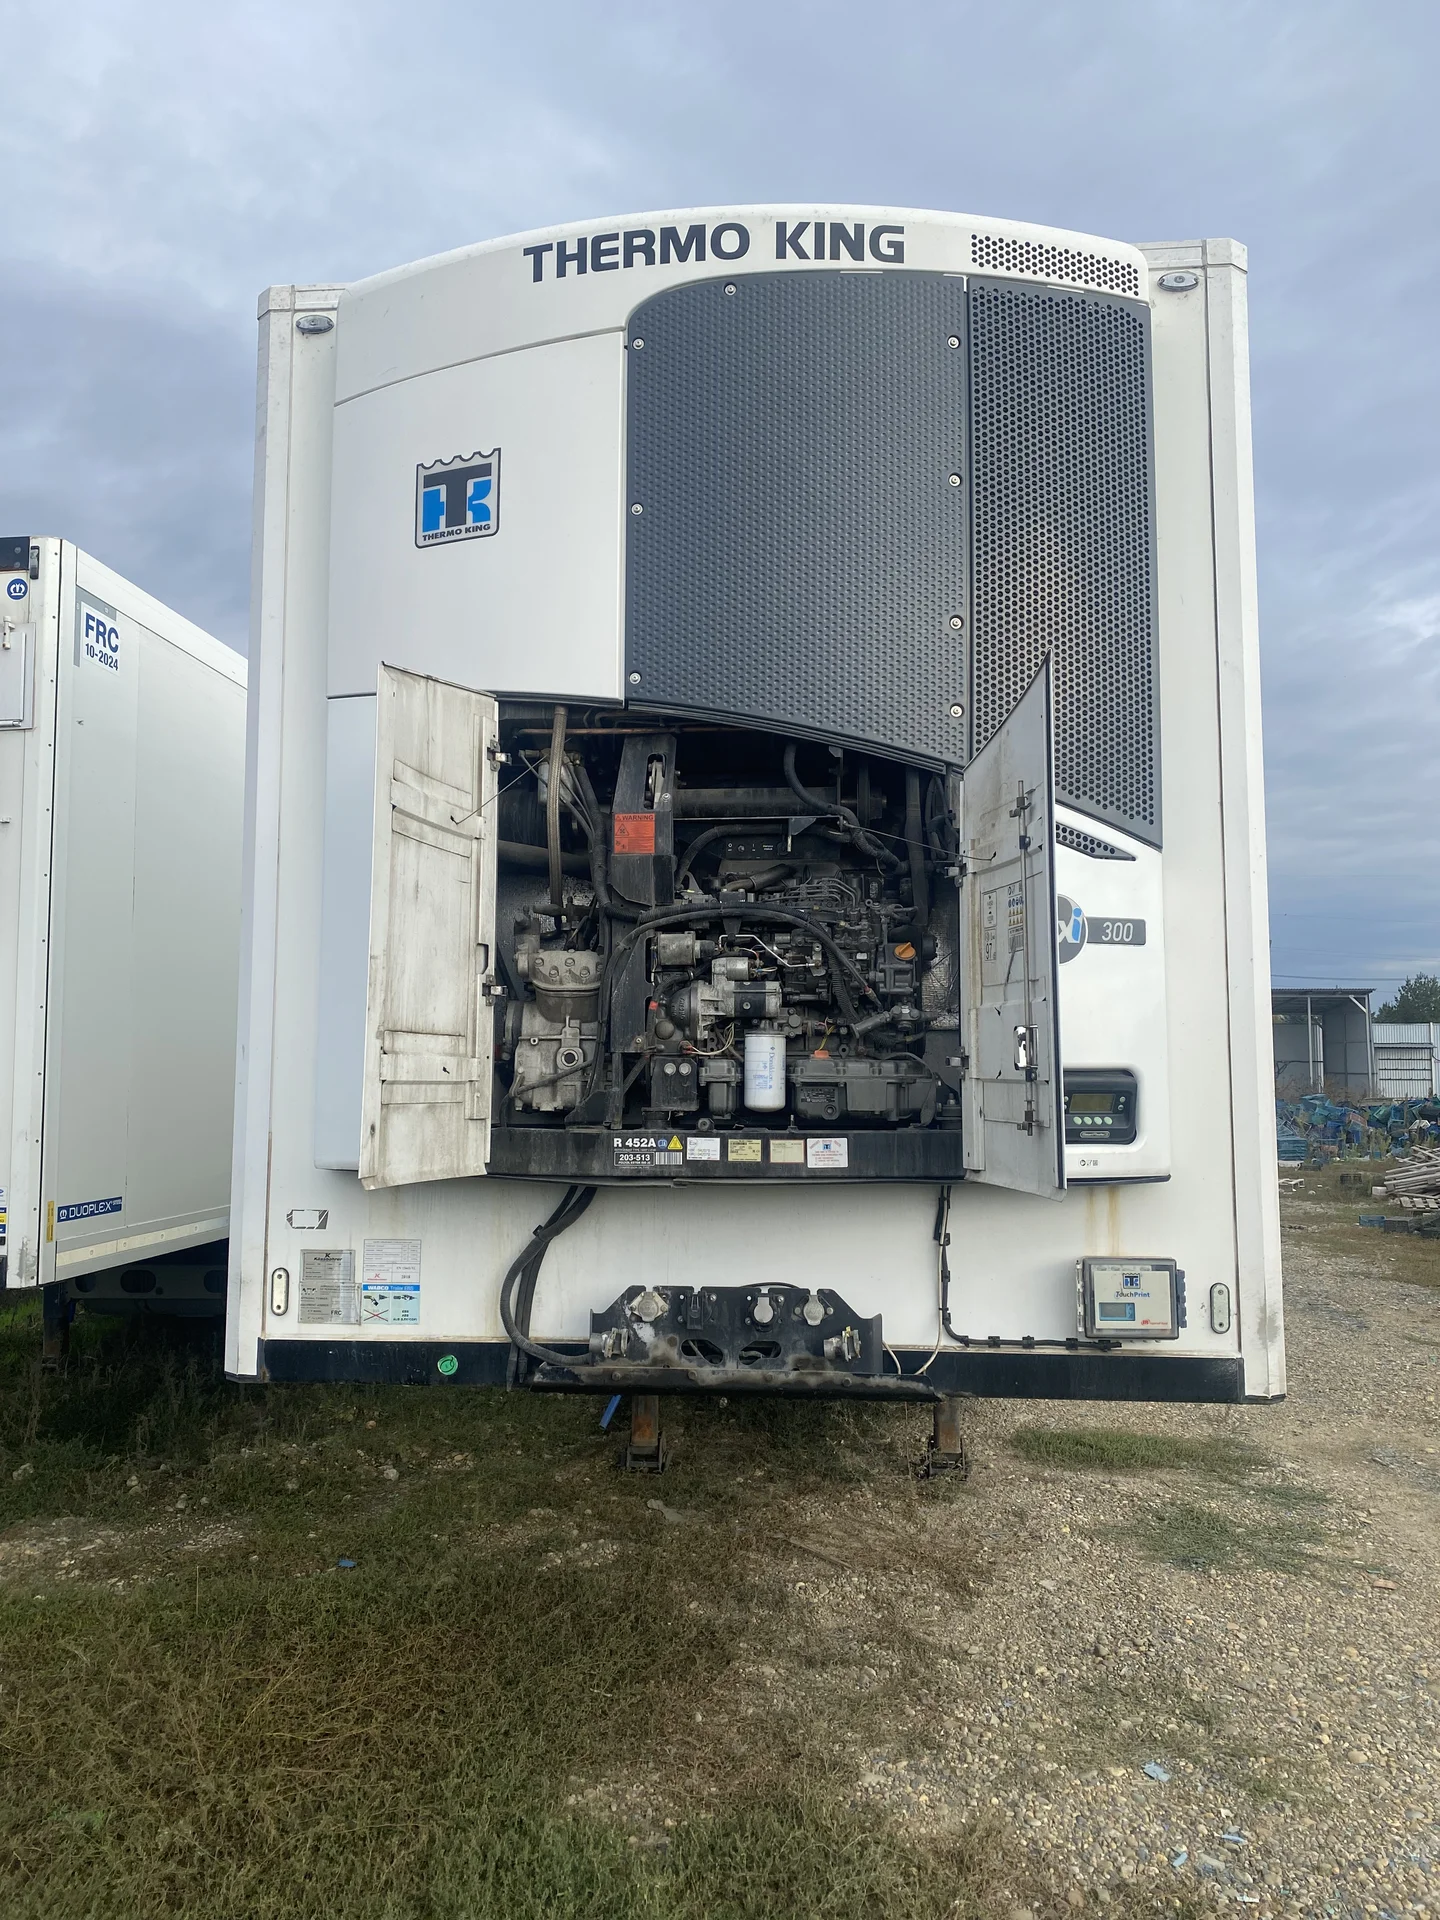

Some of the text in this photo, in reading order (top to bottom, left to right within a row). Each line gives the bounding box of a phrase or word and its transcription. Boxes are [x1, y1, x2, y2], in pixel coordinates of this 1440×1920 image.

[523, 220, 906, 283] THERMO KING
[422, 523, 491, 542] THERMO KING
[85, 612, 119, 653] FRC
[85, 643, 119, 671] 10-2024
[1101, 921, 1134, 942] 300
[613, 1137, 657, 1148] R 452A
[69, 1200, 112, 1218] DUOPLEX
